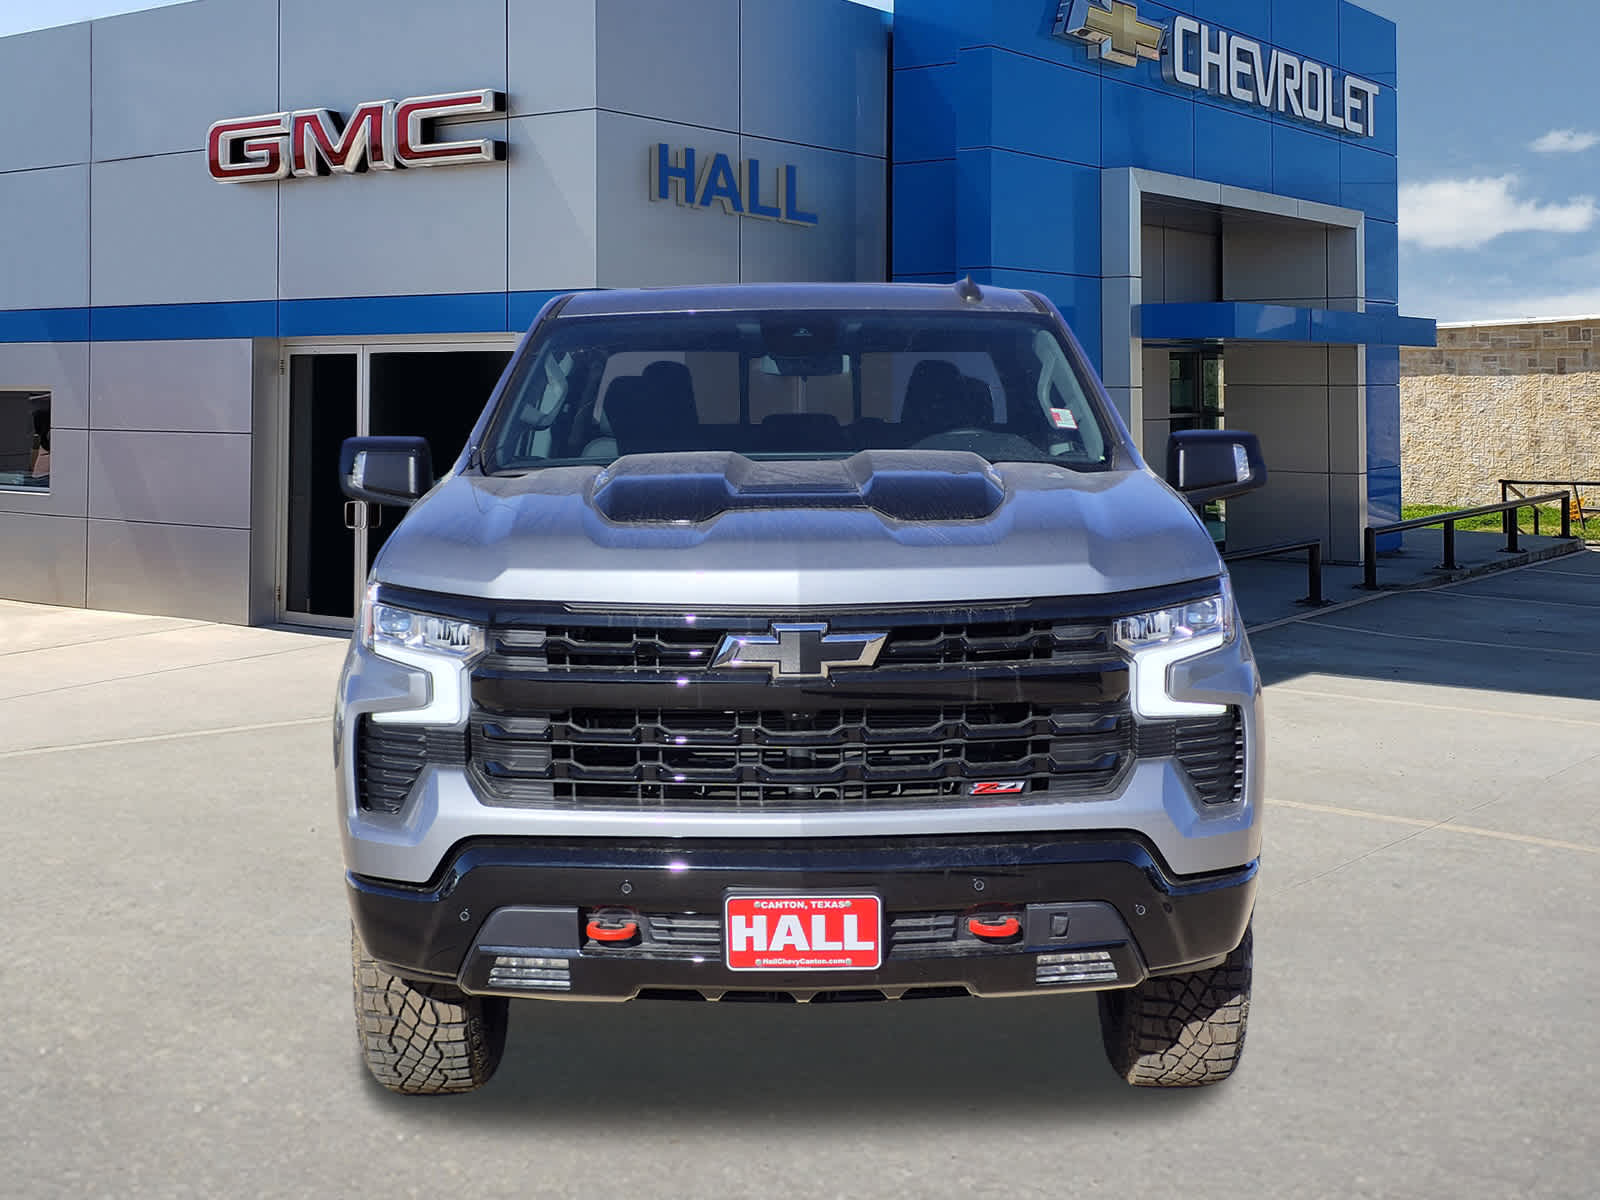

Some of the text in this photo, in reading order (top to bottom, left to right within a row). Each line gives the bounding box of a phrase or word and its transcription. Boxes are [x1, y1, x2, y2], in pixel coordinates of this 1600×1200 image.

[1174, 15, 1380, 137] CHEVROLET
[207, 88, 505, 184] GMC
[655, 143, 819, 226] HALL
[731, 914, 875, 952] HALL
[761, 900, 847, 910] CANTON, TEXAS
